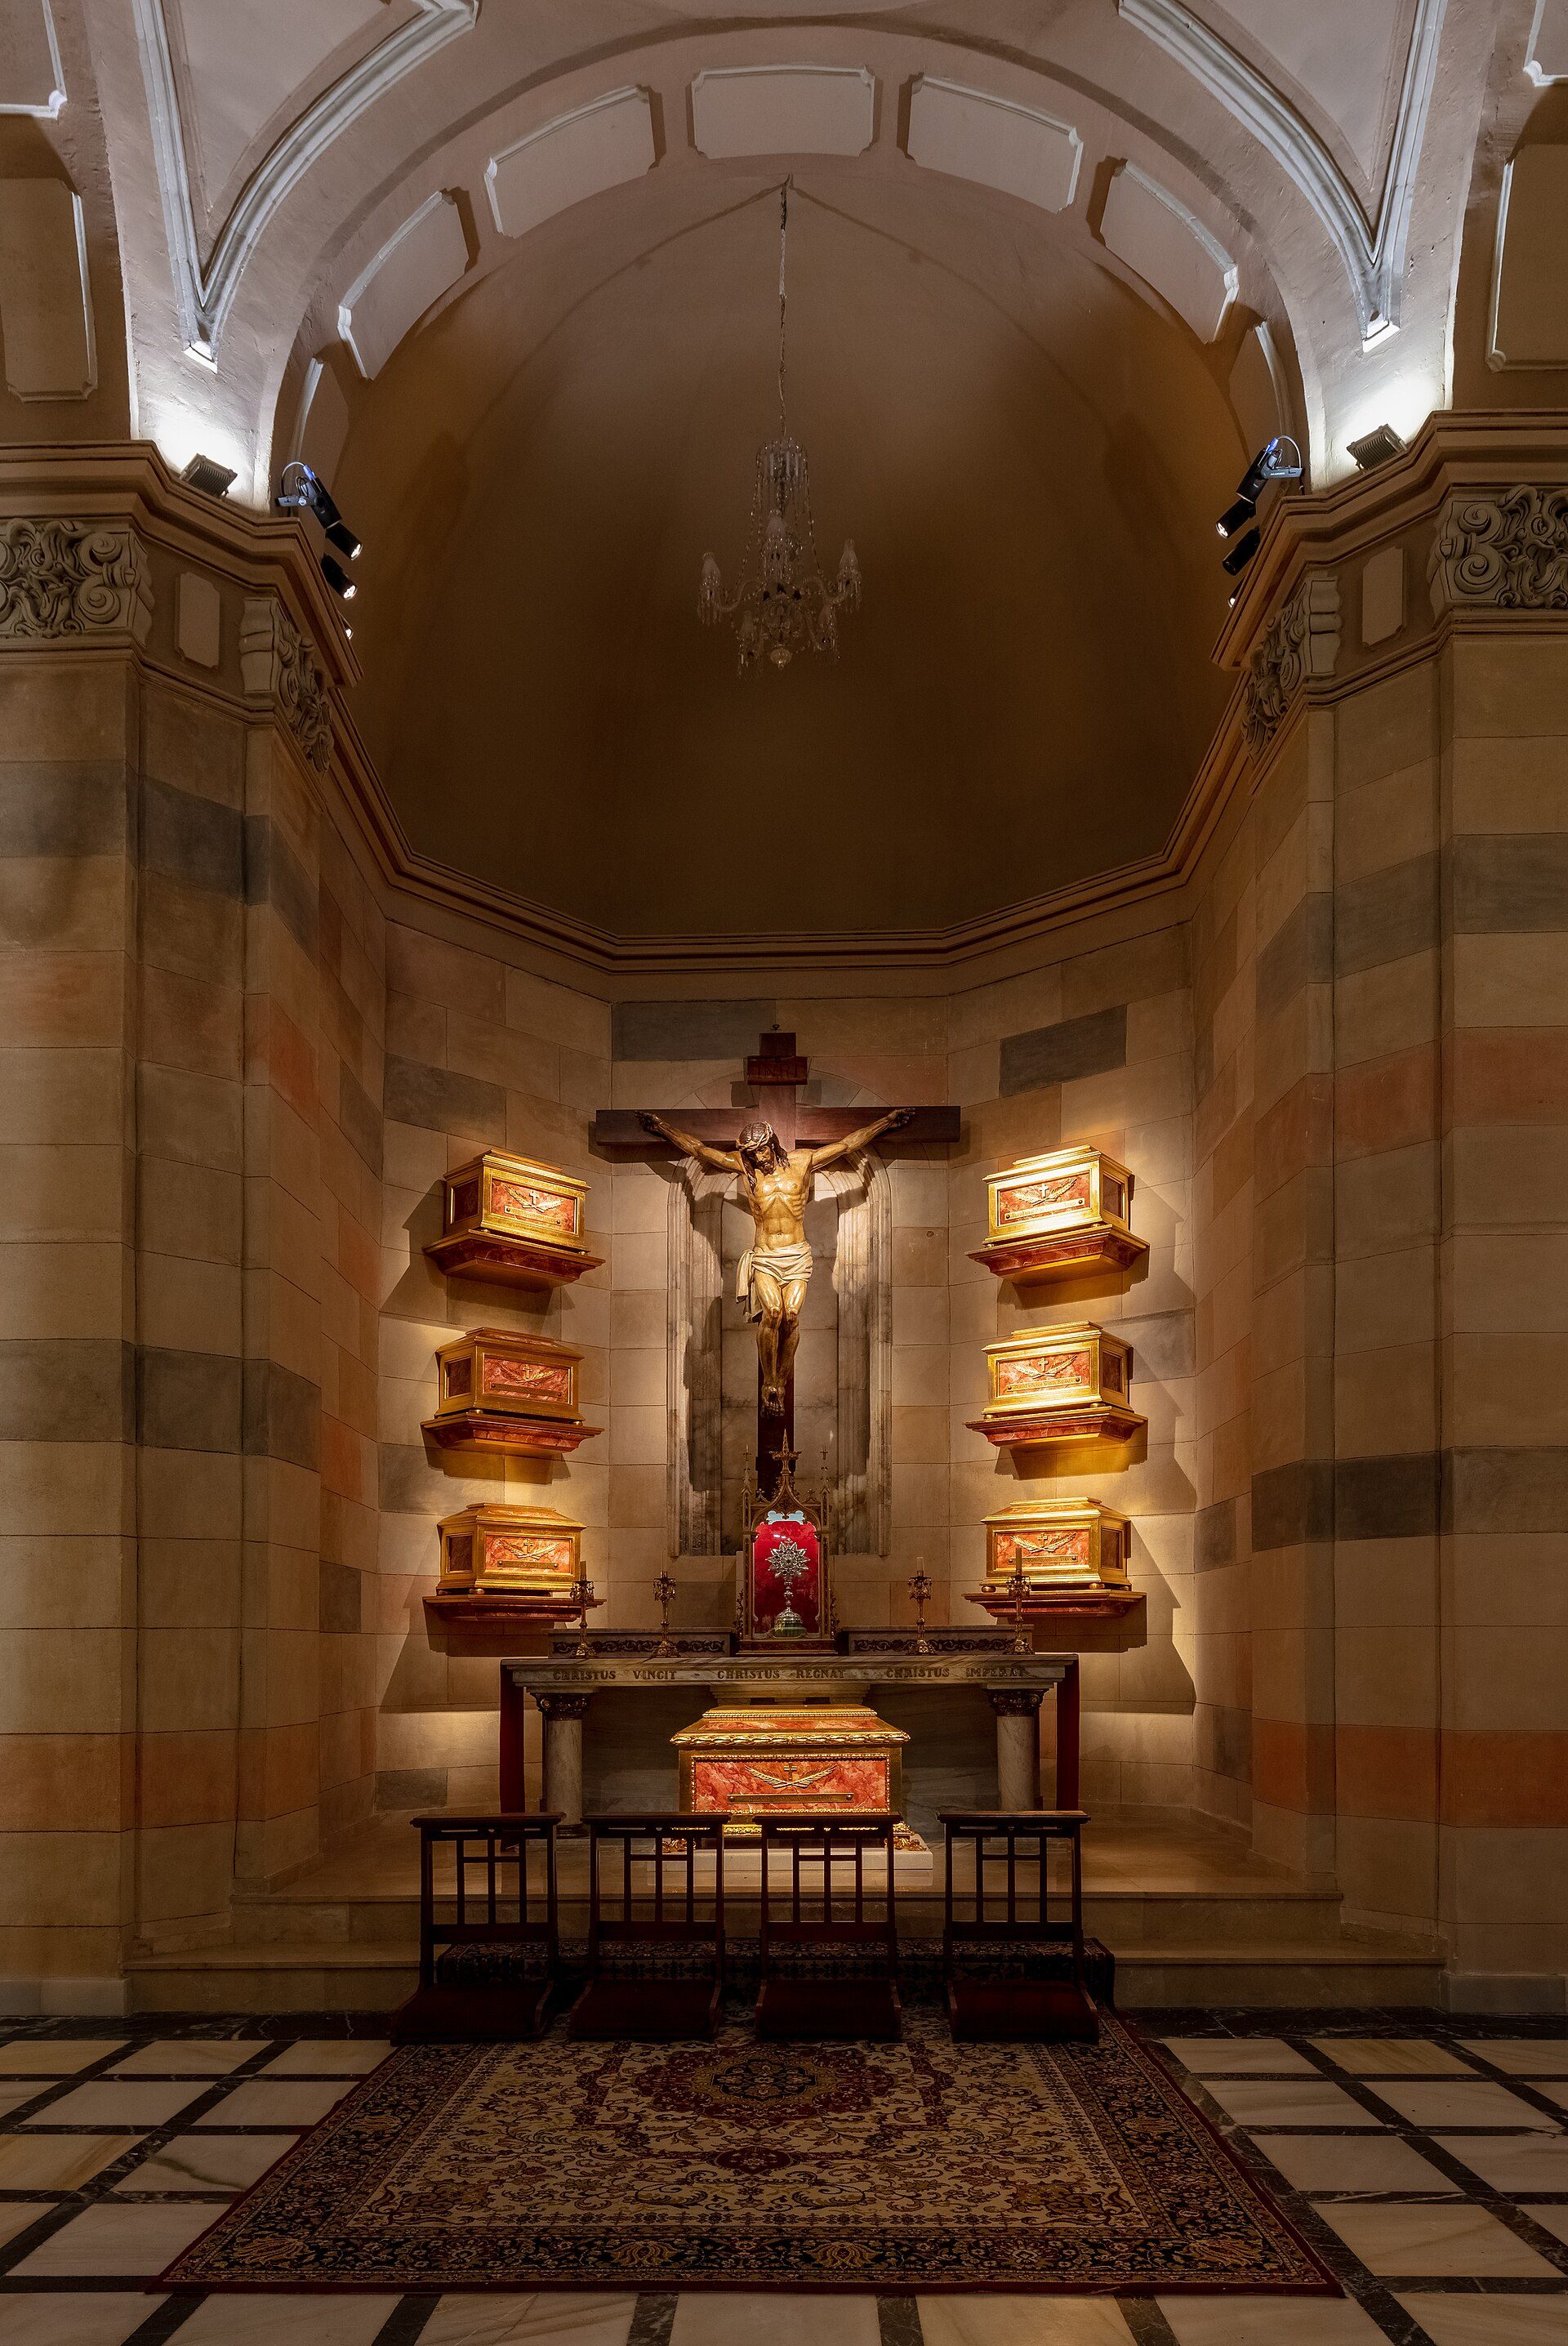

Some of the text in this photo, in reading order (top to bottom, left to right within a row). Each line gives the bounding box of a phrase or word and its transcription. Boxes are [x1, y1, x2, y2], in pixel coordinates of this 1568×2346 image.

[758, 1064, 798, 1078] INRI
[552, 1670, 617, 1680] CHRISTUS
[633, 1670, 677, 1679] VINCIT
[717, 1670, 781, 1679] CHRISTUS
[795, 1670, 846, 1679] REGNAT
[886, 1668, 950, 1678] CHRISTUS
[966, 1667, 1025, 1677] IMPERAT
